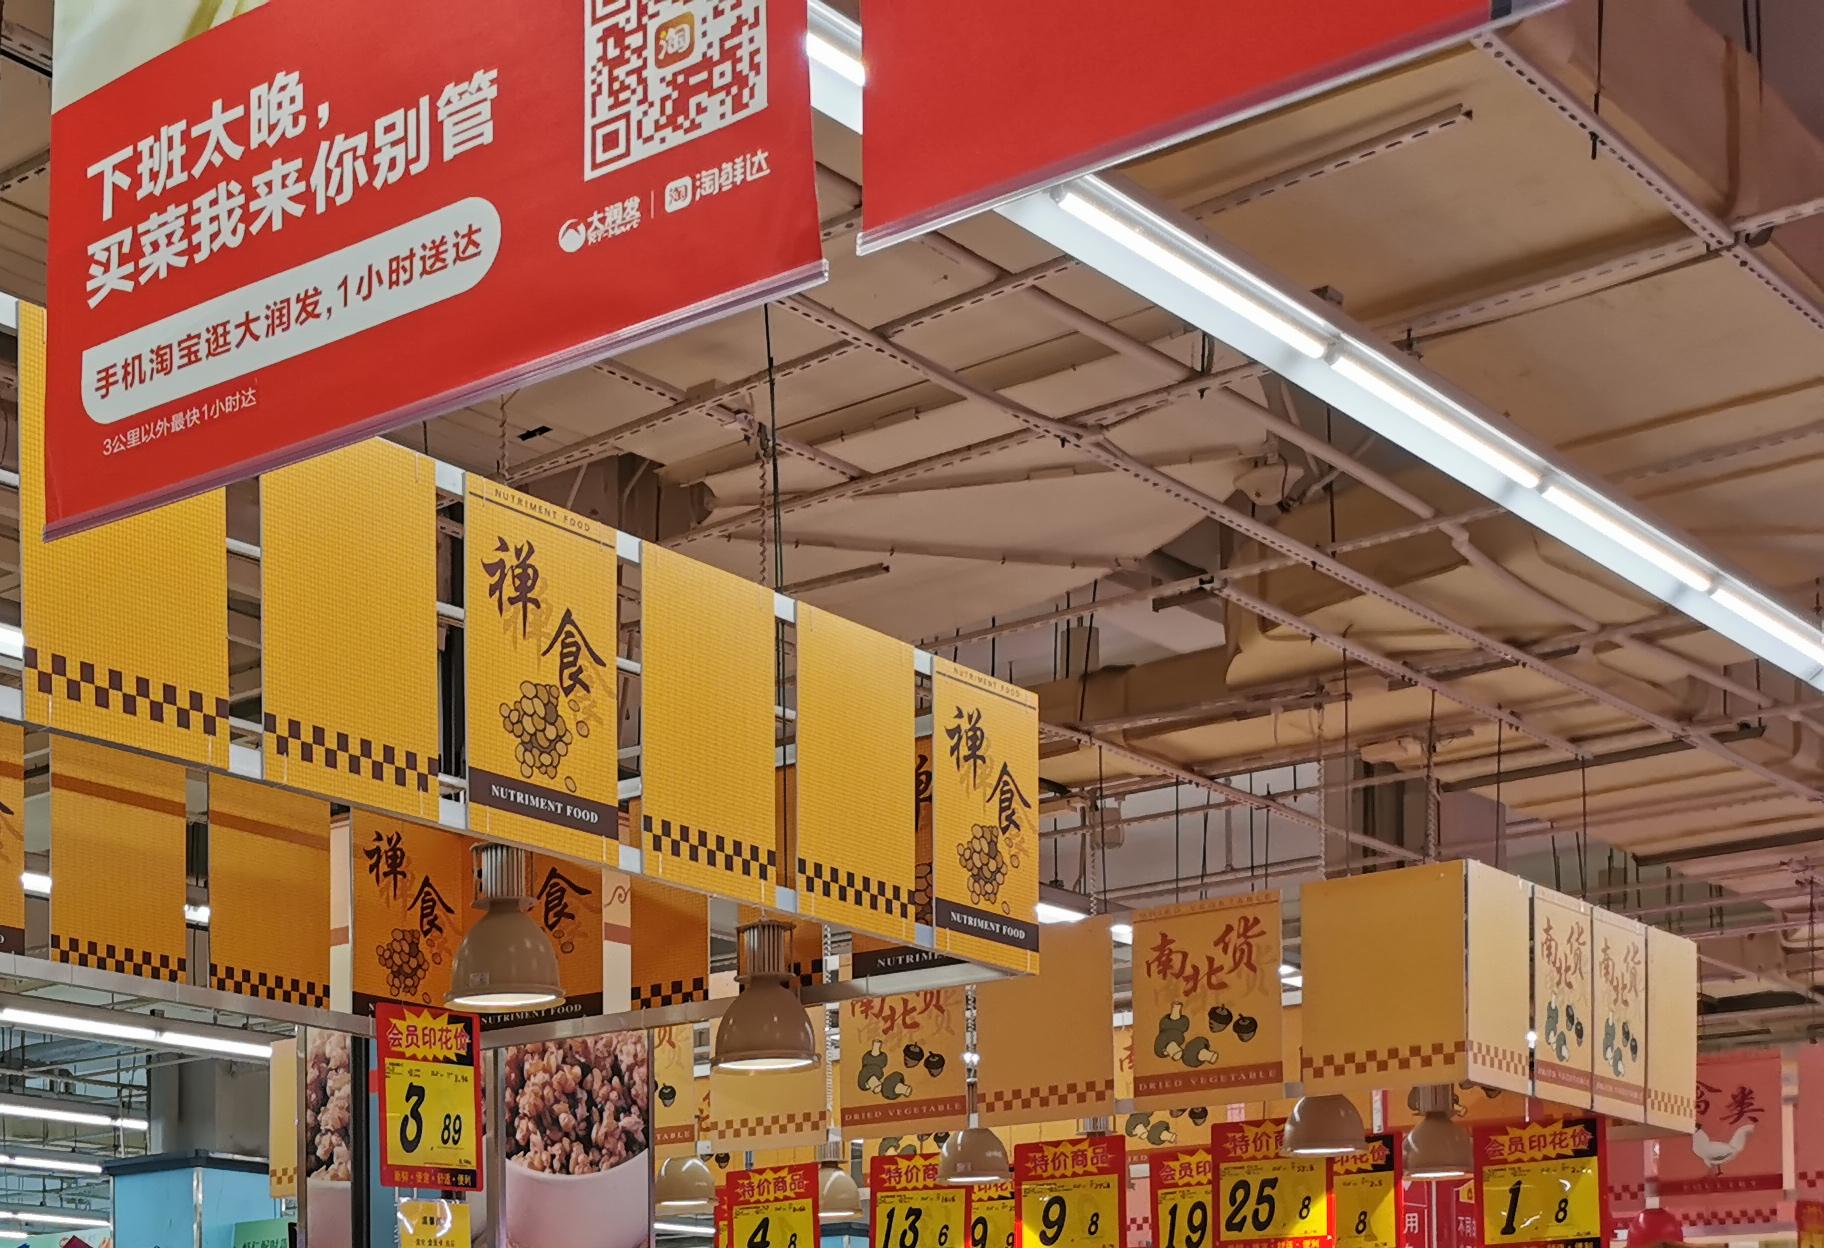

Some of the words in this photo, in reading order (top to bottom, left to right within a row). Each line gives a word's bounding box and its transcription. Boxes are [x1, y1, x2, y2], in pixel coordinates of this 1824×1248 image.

[86, 67, 499, 309] 买菜我来你别管
[695, 149, 771, 201] 淘鲜达
[587, 196, 642, 232] 大润发
[102, 385, 258, 457] 3公里以外最快1小时达
[495, 489, 557, 521] NUTRIMENT
[562, 516, 592, 532] FOOD
[481, 536, 607, 699] 禅食
[944, 705, 1032, 836] 禅食
[490, 783, 564, 815] NUTRIMENT
[567, 804, 599, 824] FOOD
[363, 830, 456, 939] 禅食
[950, 908, 998, 938] NUTRIMENT
[1000, 924, 1027, 942] FOOD
[1145, 913, 1270, 995] 南北货
[1540, 916, 1587, 990] 南北货
[1599, 938, 1645, 1008] 南北货
[480, 1007, 546, 1028] NUTRIMENT
[551, 1003, 583, 1020] FOOD
[386, 1022, 471, 1052] 会员印花价
[1139, 1077, 1184, 1092] DRIED
[1188, 1069, 1275, 1086] VEGETABLE
[844, 1110, 878, 1122] DRIED
[882, 1101, 963, 1117] VEGETABLE
[1030, 1146, 1110, 1172] 特价商品
[1485, 1127, 1592, 1160] 会员印花价
[739, 1175, 805, 1198] 特价商品
[1159, 1161, 1211, 1184] 会员印
